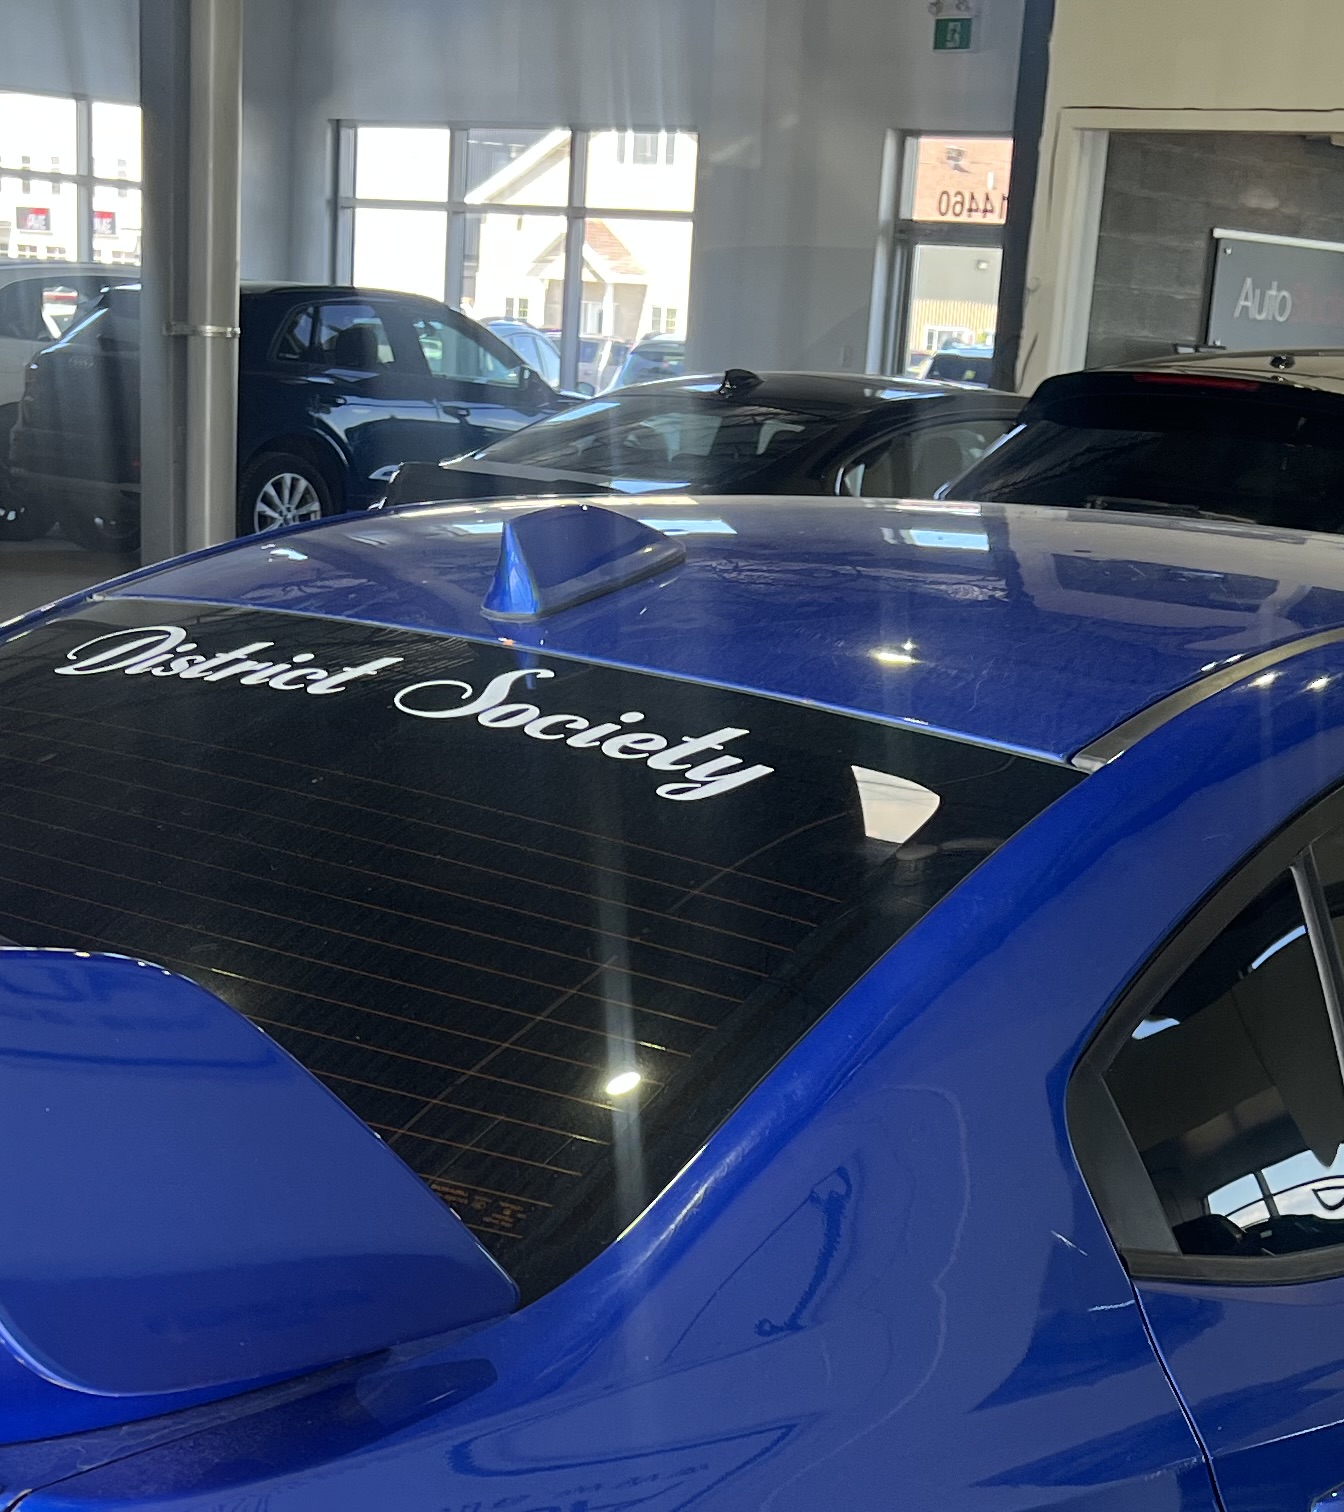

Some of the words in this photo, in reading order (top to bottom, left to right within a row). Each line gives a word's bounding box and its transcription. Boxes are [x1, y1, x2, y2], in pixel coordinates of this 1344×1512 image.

[1233, 277, 1292, 322] Auto
[53, 625, 405, 695] District
[393, 668, 775, 801] Society
